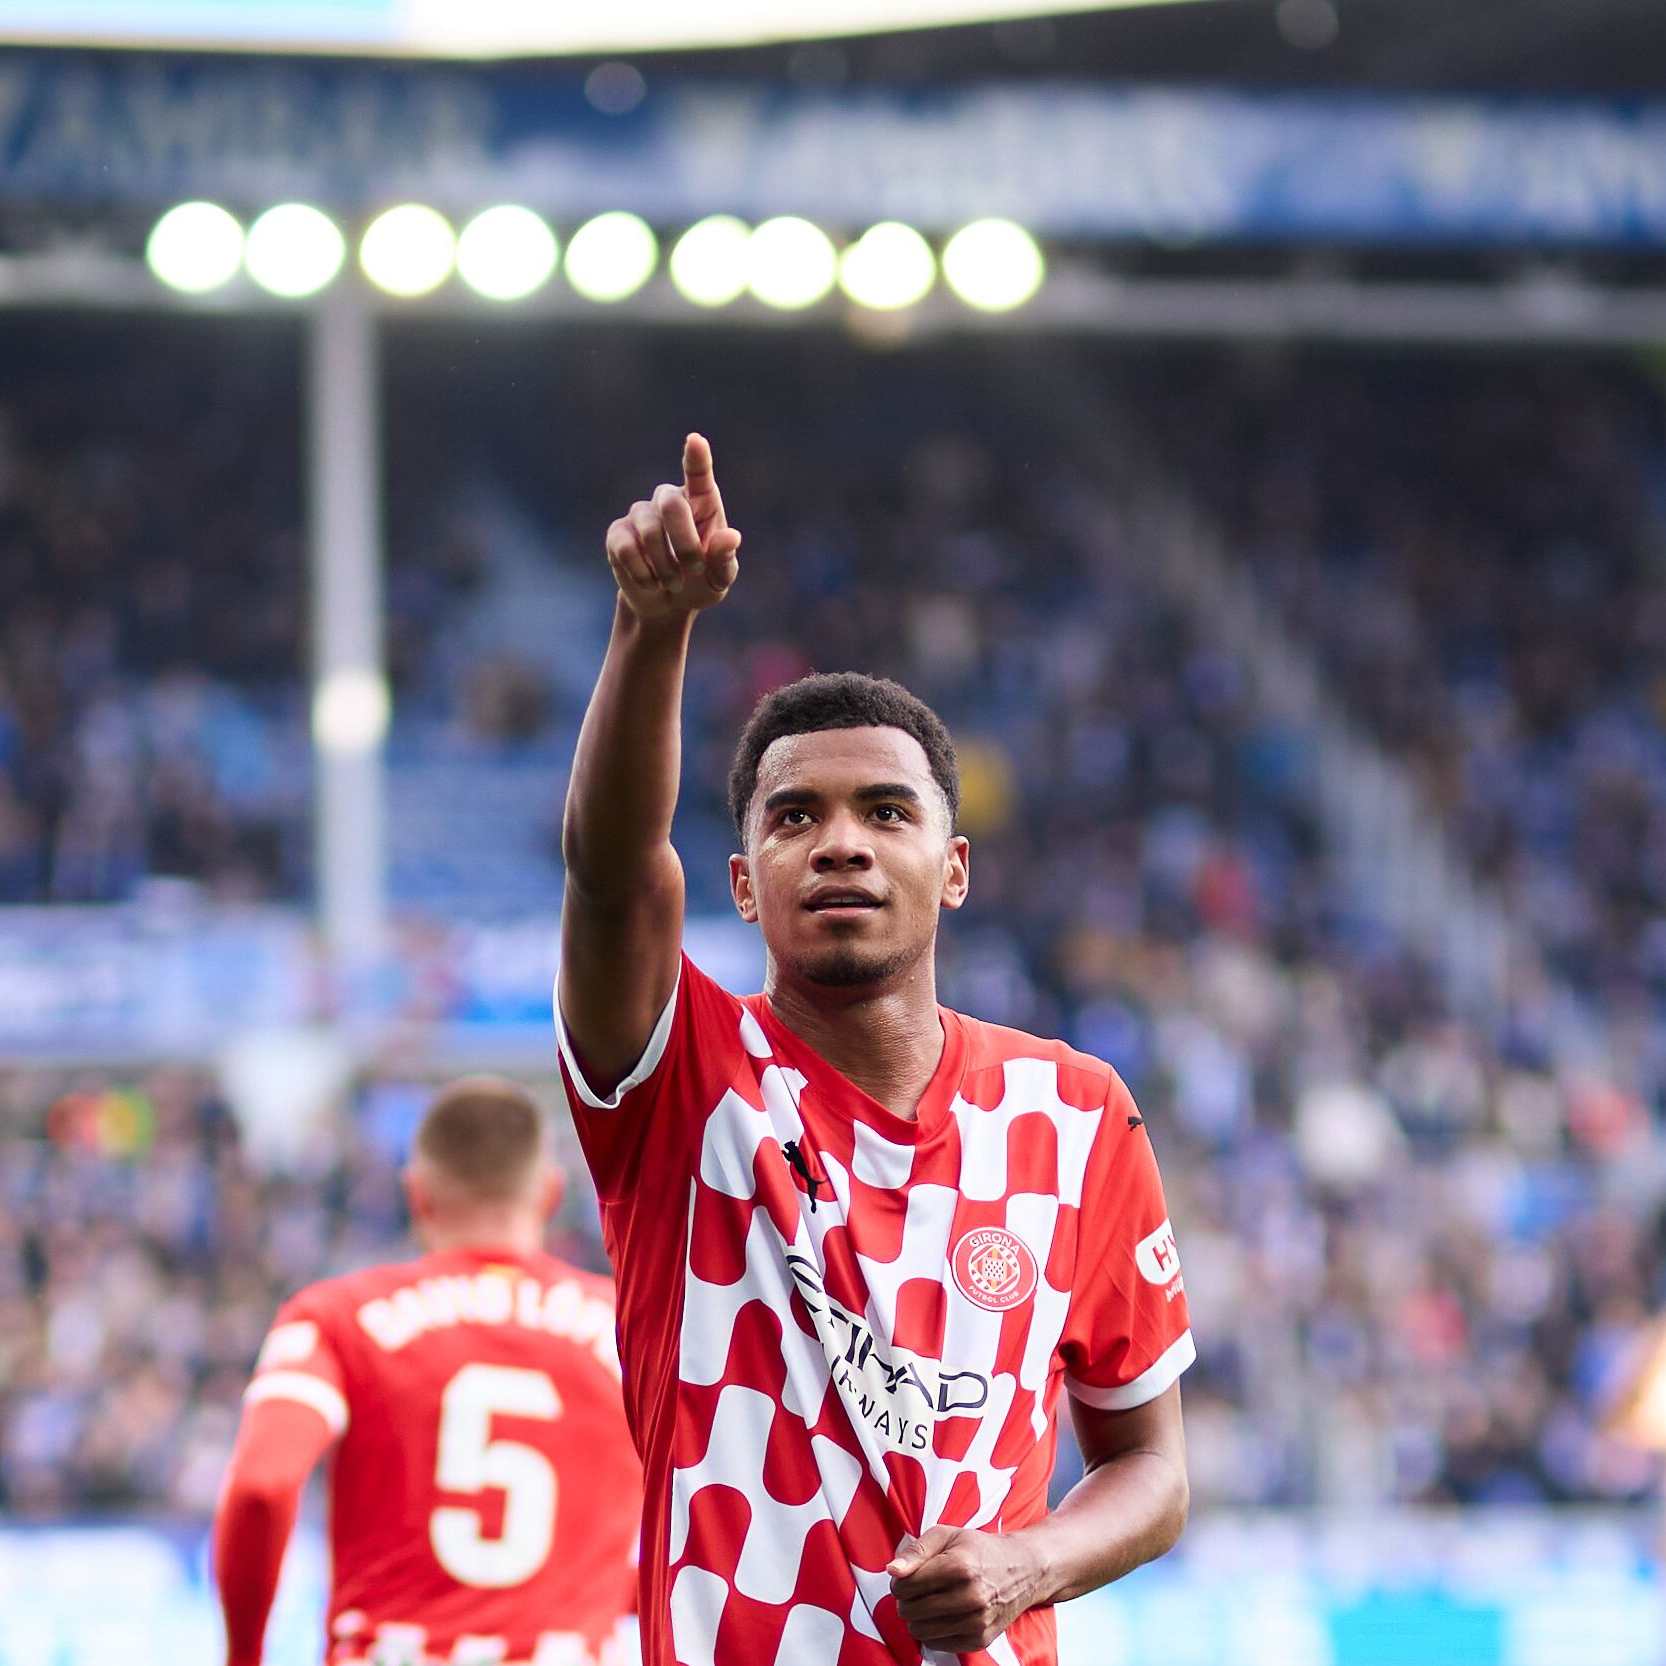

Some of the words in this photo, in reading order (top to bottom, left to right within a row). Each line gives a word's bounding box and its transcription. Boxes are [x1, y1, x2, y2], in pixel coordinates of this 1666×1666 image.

[969, 1232, 1020, 1256] GIRONA
[968, 1285, 998, 1303] FUTBOL
[1000, 1291, 1020, 1303] CLUB
[431, 1361, 563, 1588] 5
